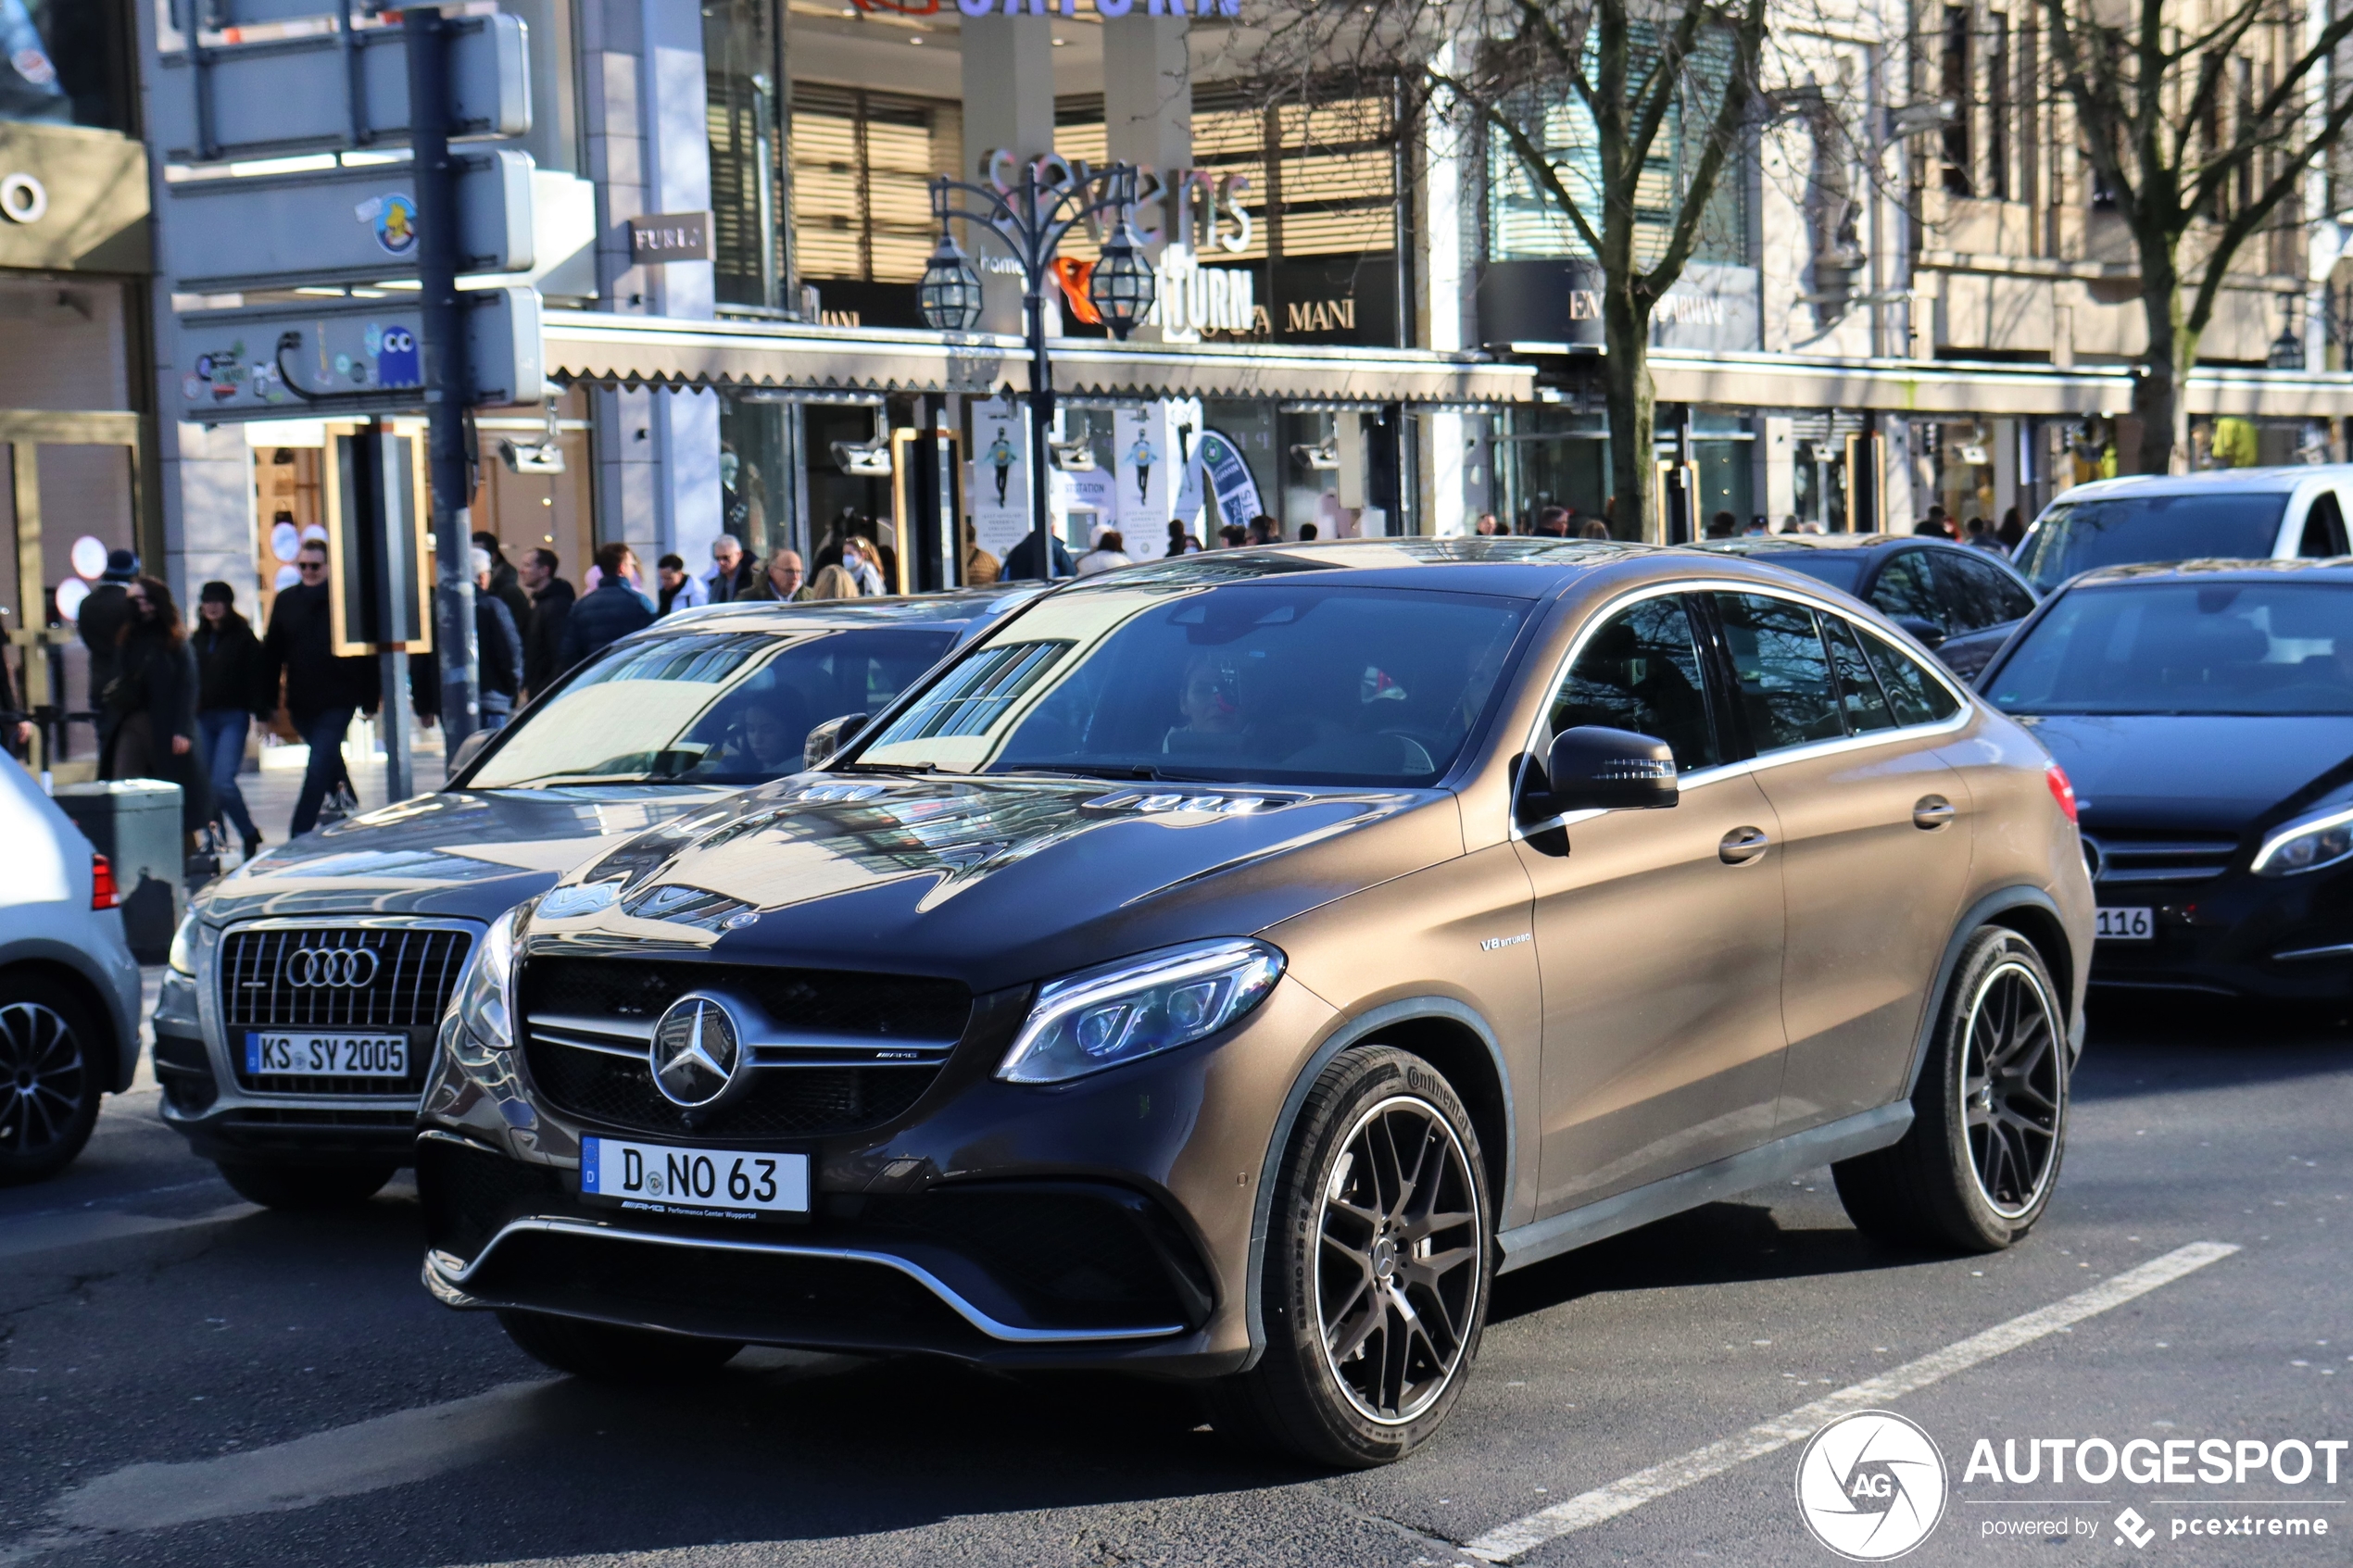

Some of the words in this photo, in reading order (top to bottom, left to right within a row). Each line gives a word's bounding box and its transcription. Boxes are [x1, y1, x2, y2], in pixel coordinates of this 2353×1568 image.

[1149, 266, 1253, 330] ATURN
[2097, 911, 2147, 935] 116
[1480, 937, 1499, 951] V8
[1500, 933, 1530, 947] BITURBO
[262, 1038, 291, 1069] KS
[309, 1038, 338, 1070] SY
[345, 1039, 403, 1071] 2005
[1406, 1066, 1470, 1133] Continental
[586, 1171, 595, 1184] D
[623, 1148, 643, 1191] D
[666, 1152, 716, 1198] NO
[728, 1157, 776, 1202] 63
[667, 1207, 703, 1216] Performance
[704, 1210, 724, 1218] Center
[724, 1211, 757, 1220] Wuppertal
